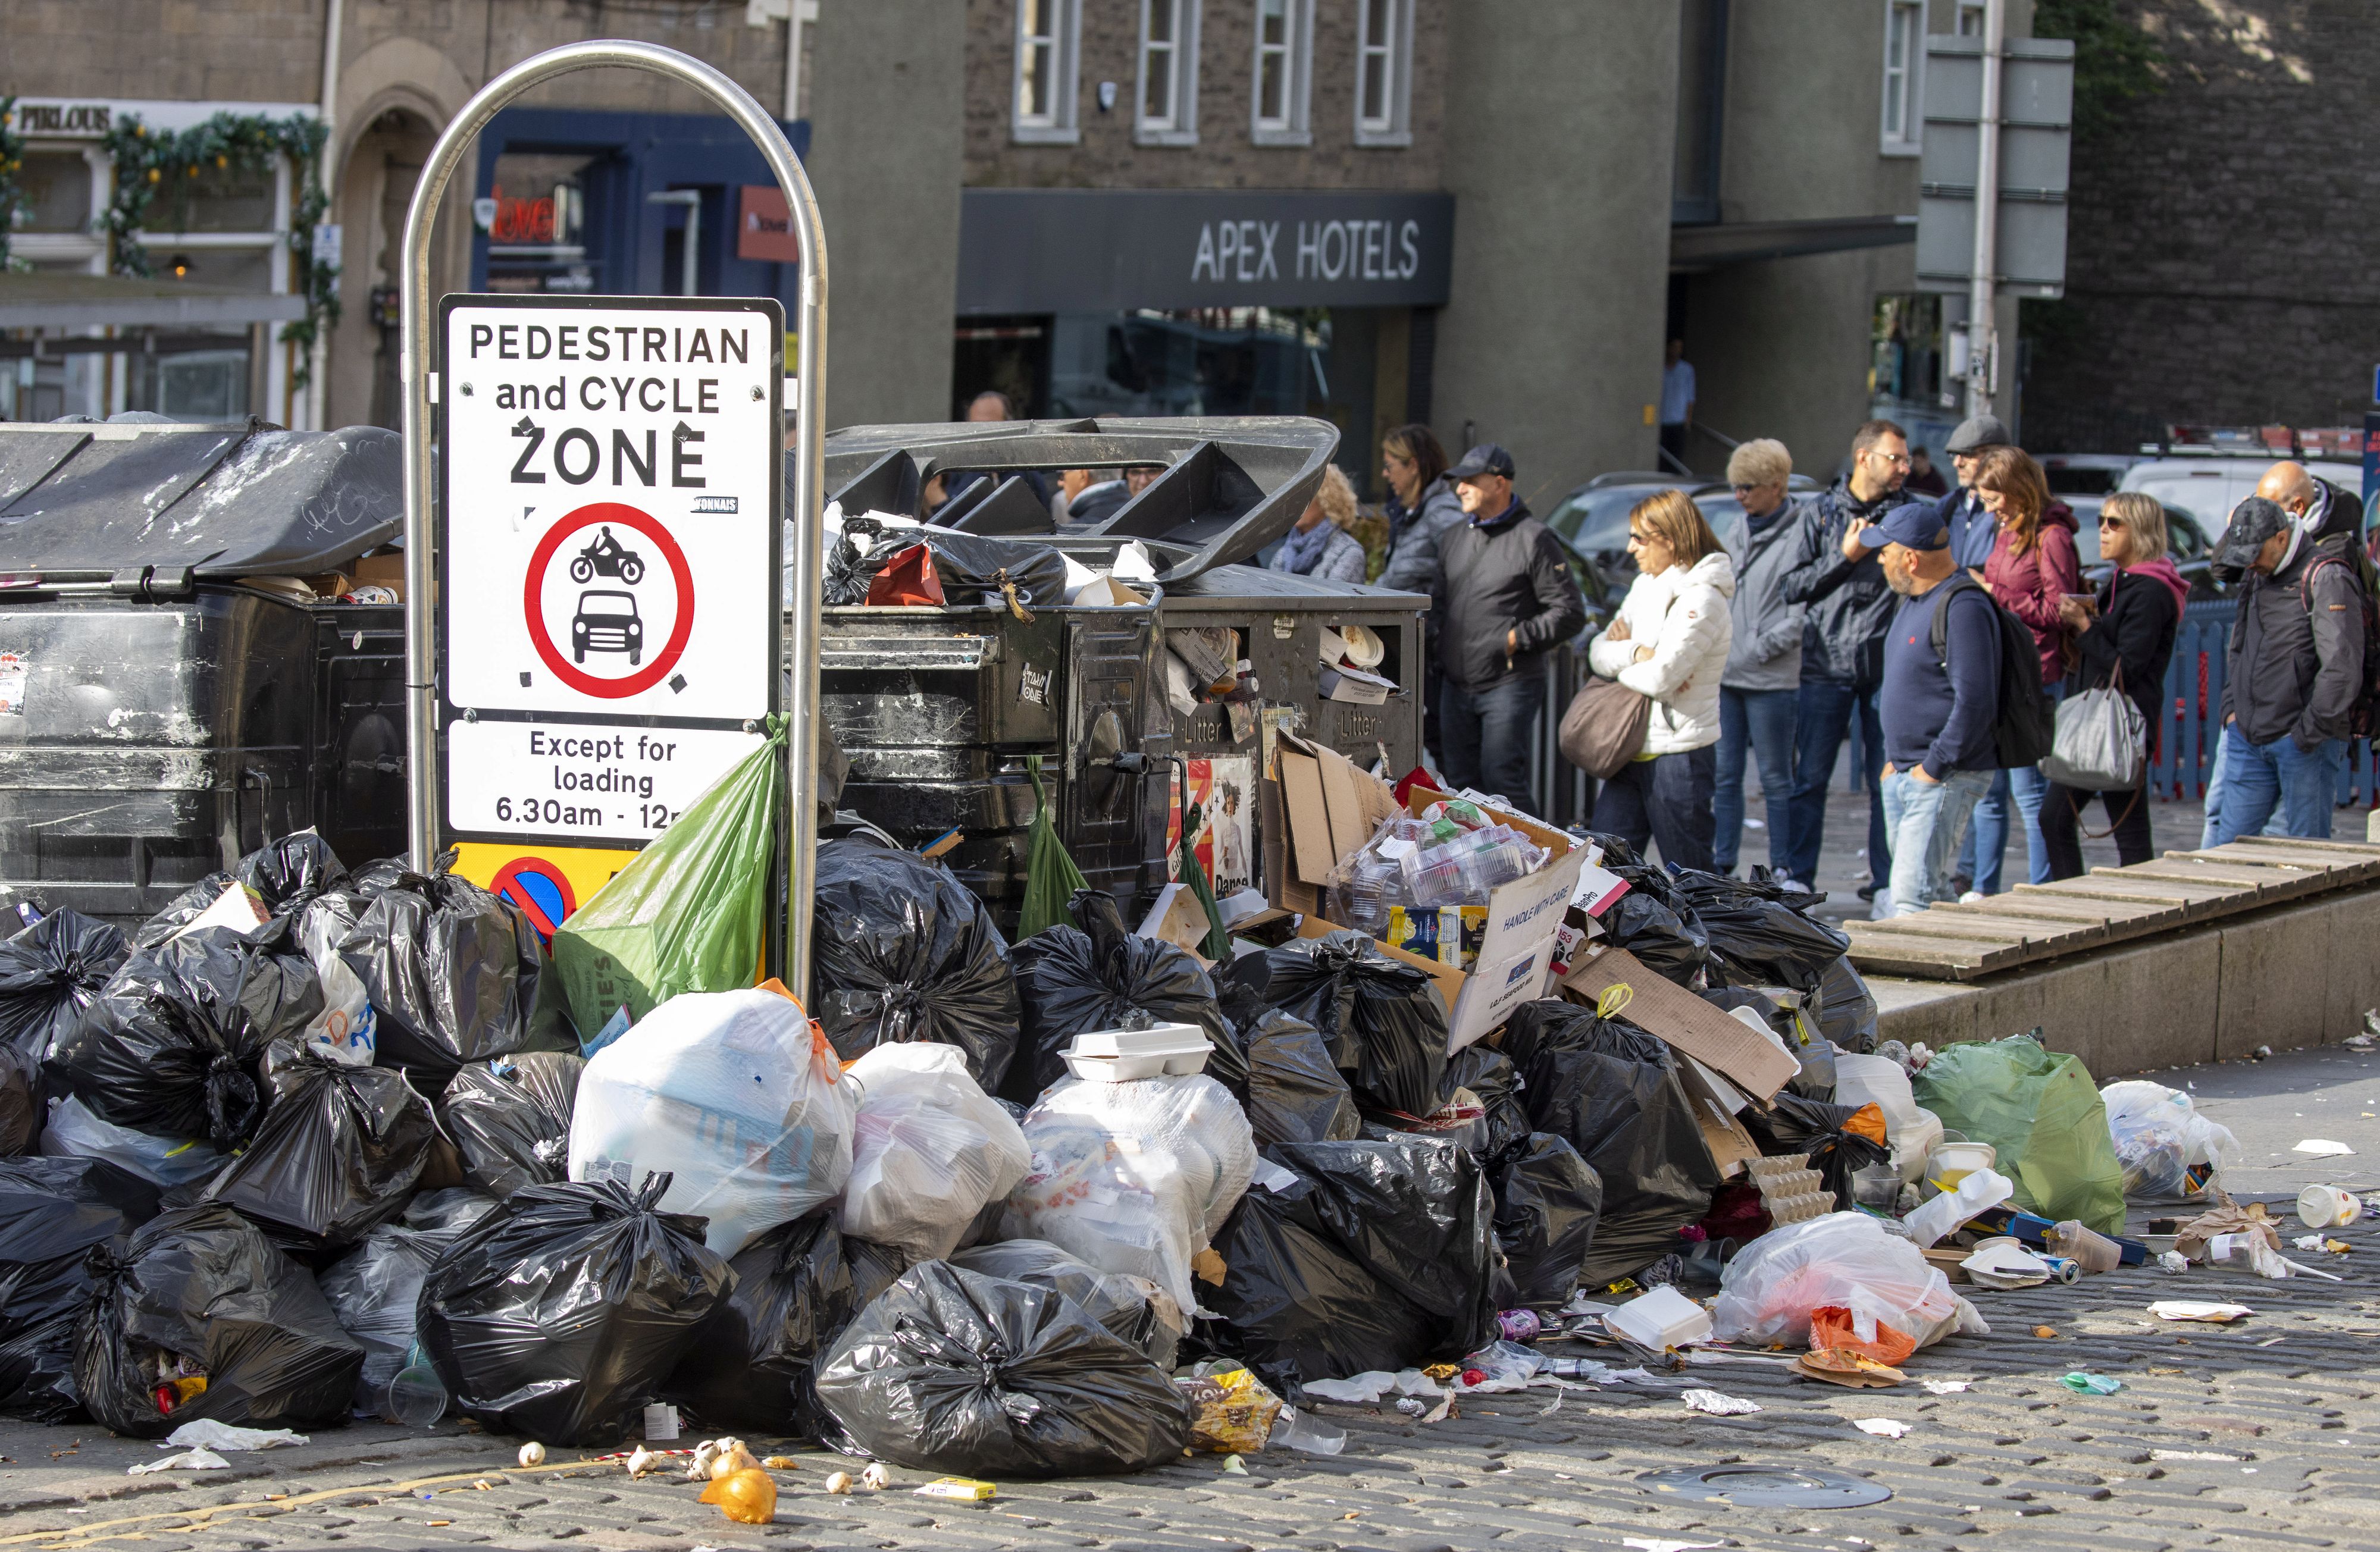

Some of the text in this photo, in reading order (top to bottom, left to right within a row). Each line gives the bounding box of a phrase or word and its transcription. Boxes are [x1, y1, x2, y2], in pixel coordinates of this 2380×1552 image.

[1191, 218, 1420, 282] APEX HOTELS
[470, 324, 749, 364] PEDESTRIAN
[496, 376, 719, 413] and CYCLE
[510, 426, 706, 488] ZONE
[1024, 686, 1042, 704] ONE
[1185, 716, 1222, 743] Litter
[1341, 711, 1377, 737] Litter
[530, 730, 677, 762] Except for
[554, 766, 653, 798] loading
[496, 797, 602, 826] 6.30am
[1503, 885, 1570, 932] HANDLE WITH CARE
[1502, 982, 1525, 1001] SEAFOOD
[613, 1020, 626, 1040] nearly
